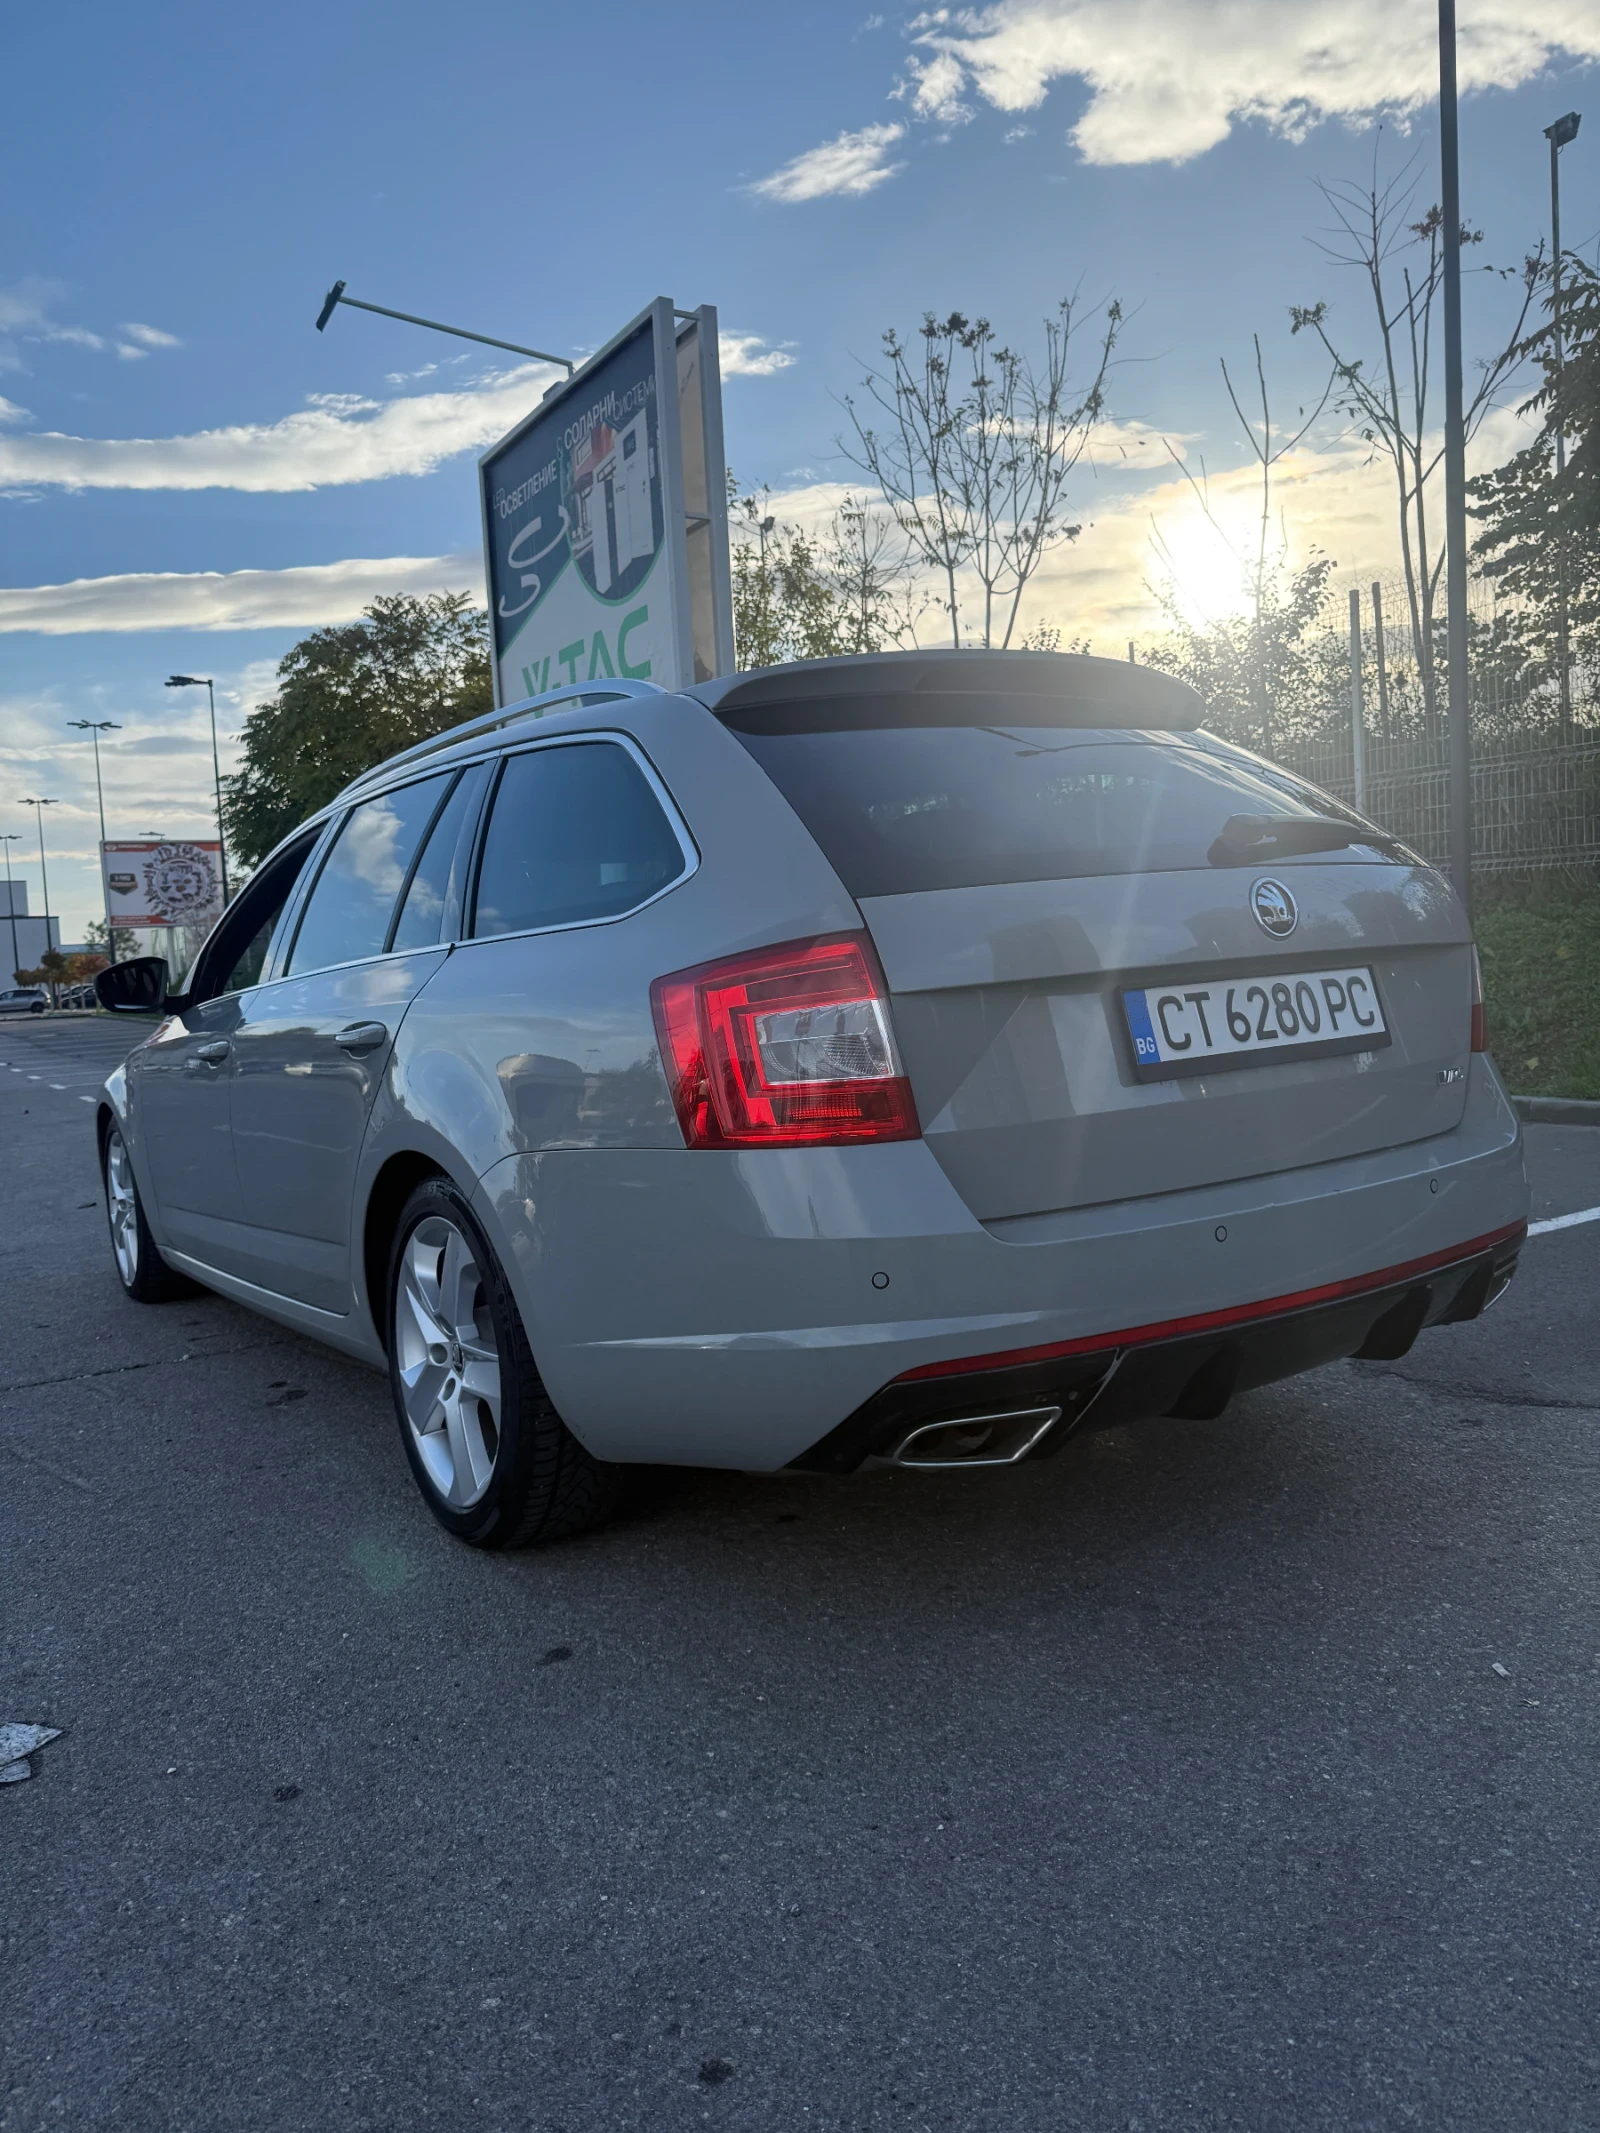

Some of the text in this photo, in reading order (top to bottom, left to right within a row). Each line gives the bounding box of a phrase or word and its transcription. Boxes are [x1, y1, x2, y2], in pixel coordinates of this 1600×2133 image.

[500, 459, 558, 519] ОСВЕТЛЕНИЕ
[564, 390, 615, 449] СОЛАРНИ
[1136, 1037, 1155, 1055] BG
[1157, 976, 1375, 1051] CT 6280 PC
